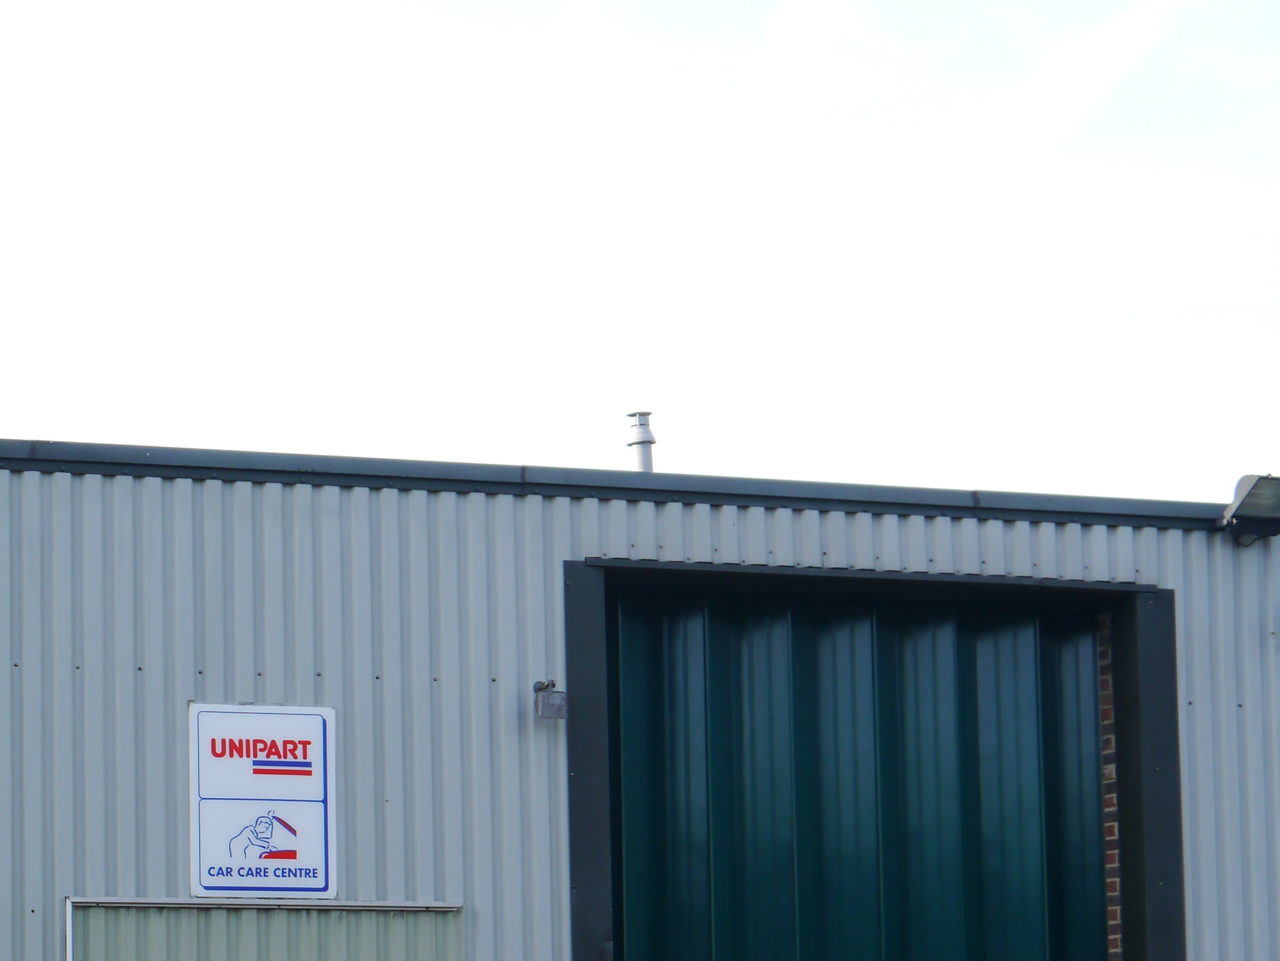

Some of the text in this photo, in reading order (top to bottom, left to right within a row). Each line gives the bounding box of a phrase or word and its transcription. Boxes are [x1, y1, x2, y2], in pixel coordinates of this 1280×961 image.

[210, 737, 312, 760] UNIPART
[207, 866, 318, 879] CAR CARE CENTRE
